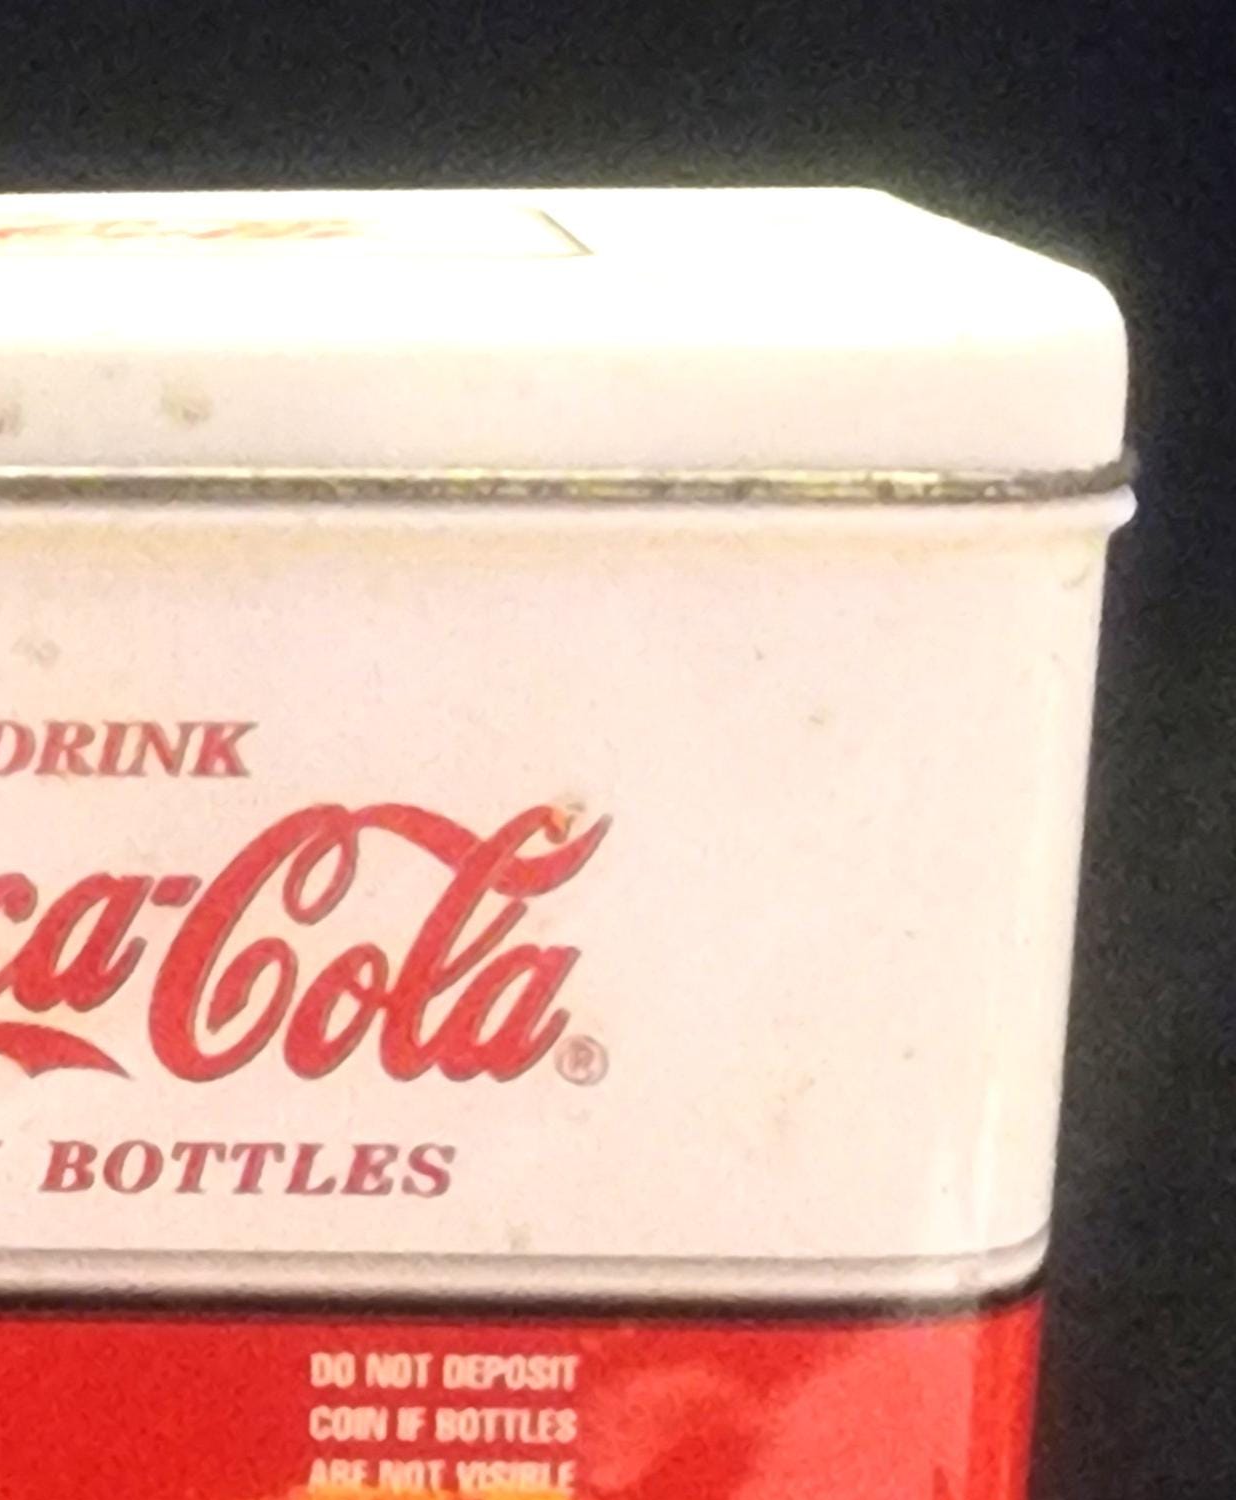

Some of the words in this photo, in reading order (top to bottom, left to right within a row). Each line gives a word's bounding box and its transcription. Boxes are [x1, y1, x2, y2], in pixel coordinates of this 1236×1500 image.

[42, 1140, 456, 1196] BOTTLES
[310, 1352, 356, 1388] DO
[365, 1352, 433, 1389] NOT
[442, 1354, 580, 1392] DEPOSIT
[309, 1405, 388, 1441] COIN
[397, 1406, 427, 1442] IF
[435, 1407, 577, 1444] BOTTLES
[309, 1458, 367, 1491] ARE
[378, 1459, 445, 1494] NOT
[456, 1459, 576, 1495] VISIBLE
